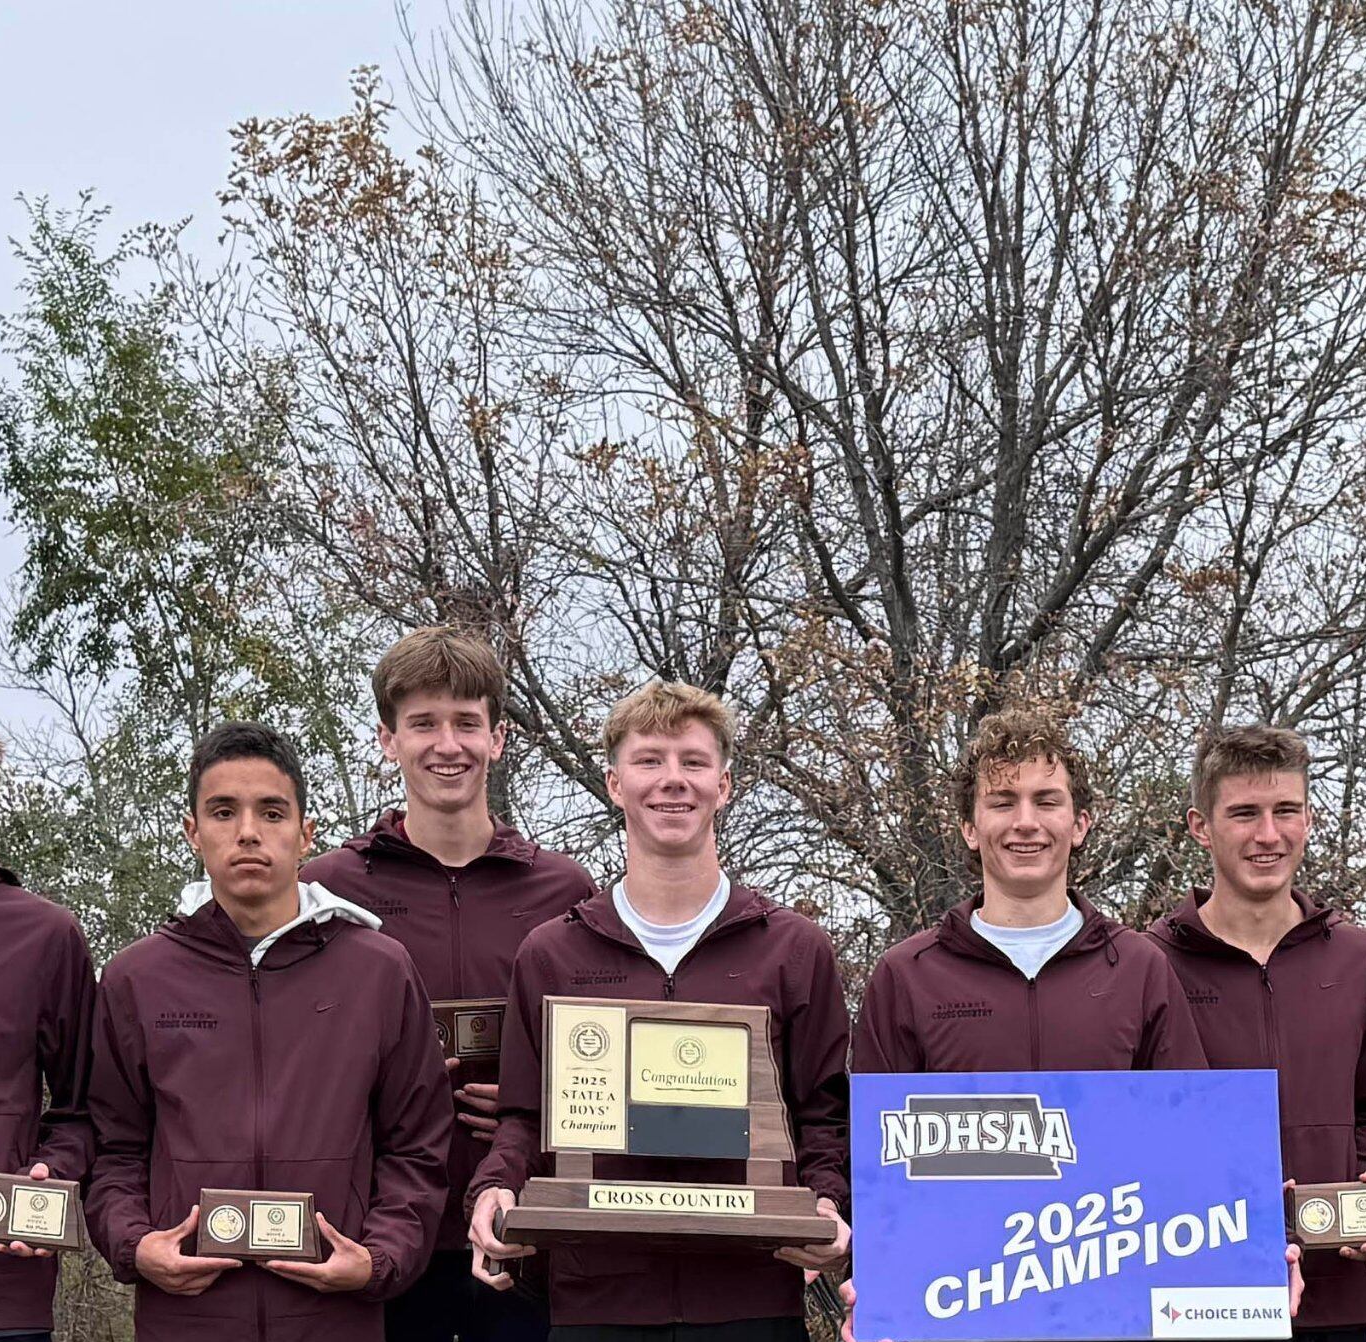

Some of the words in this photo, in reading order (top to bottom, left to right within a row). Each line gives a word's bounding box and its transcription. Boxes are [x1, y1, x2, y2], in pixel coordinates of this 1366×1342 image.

[571, 1075, 608, 1087] 2025
[640, 1068, 738, 1089] Congratulations
[561, 1089, 605, 1101] STATE
[606, 1093, 616, 1102] A
[560, 1119, 617, 1133] Champion
[883, 1110, 1075, 1162] NDHSAA
[593, 1189, 654, 1206] CROSS
[659, 1192, 751, 1210] COUNTRY
[1002, 1181, 1145, 1257] 2025
[924, 1198, 1249, 1320] CHAMPION
[1184, 1307, 1238, 1321] CHOICE
[1241, 1306, 1283, 1321] BANK
